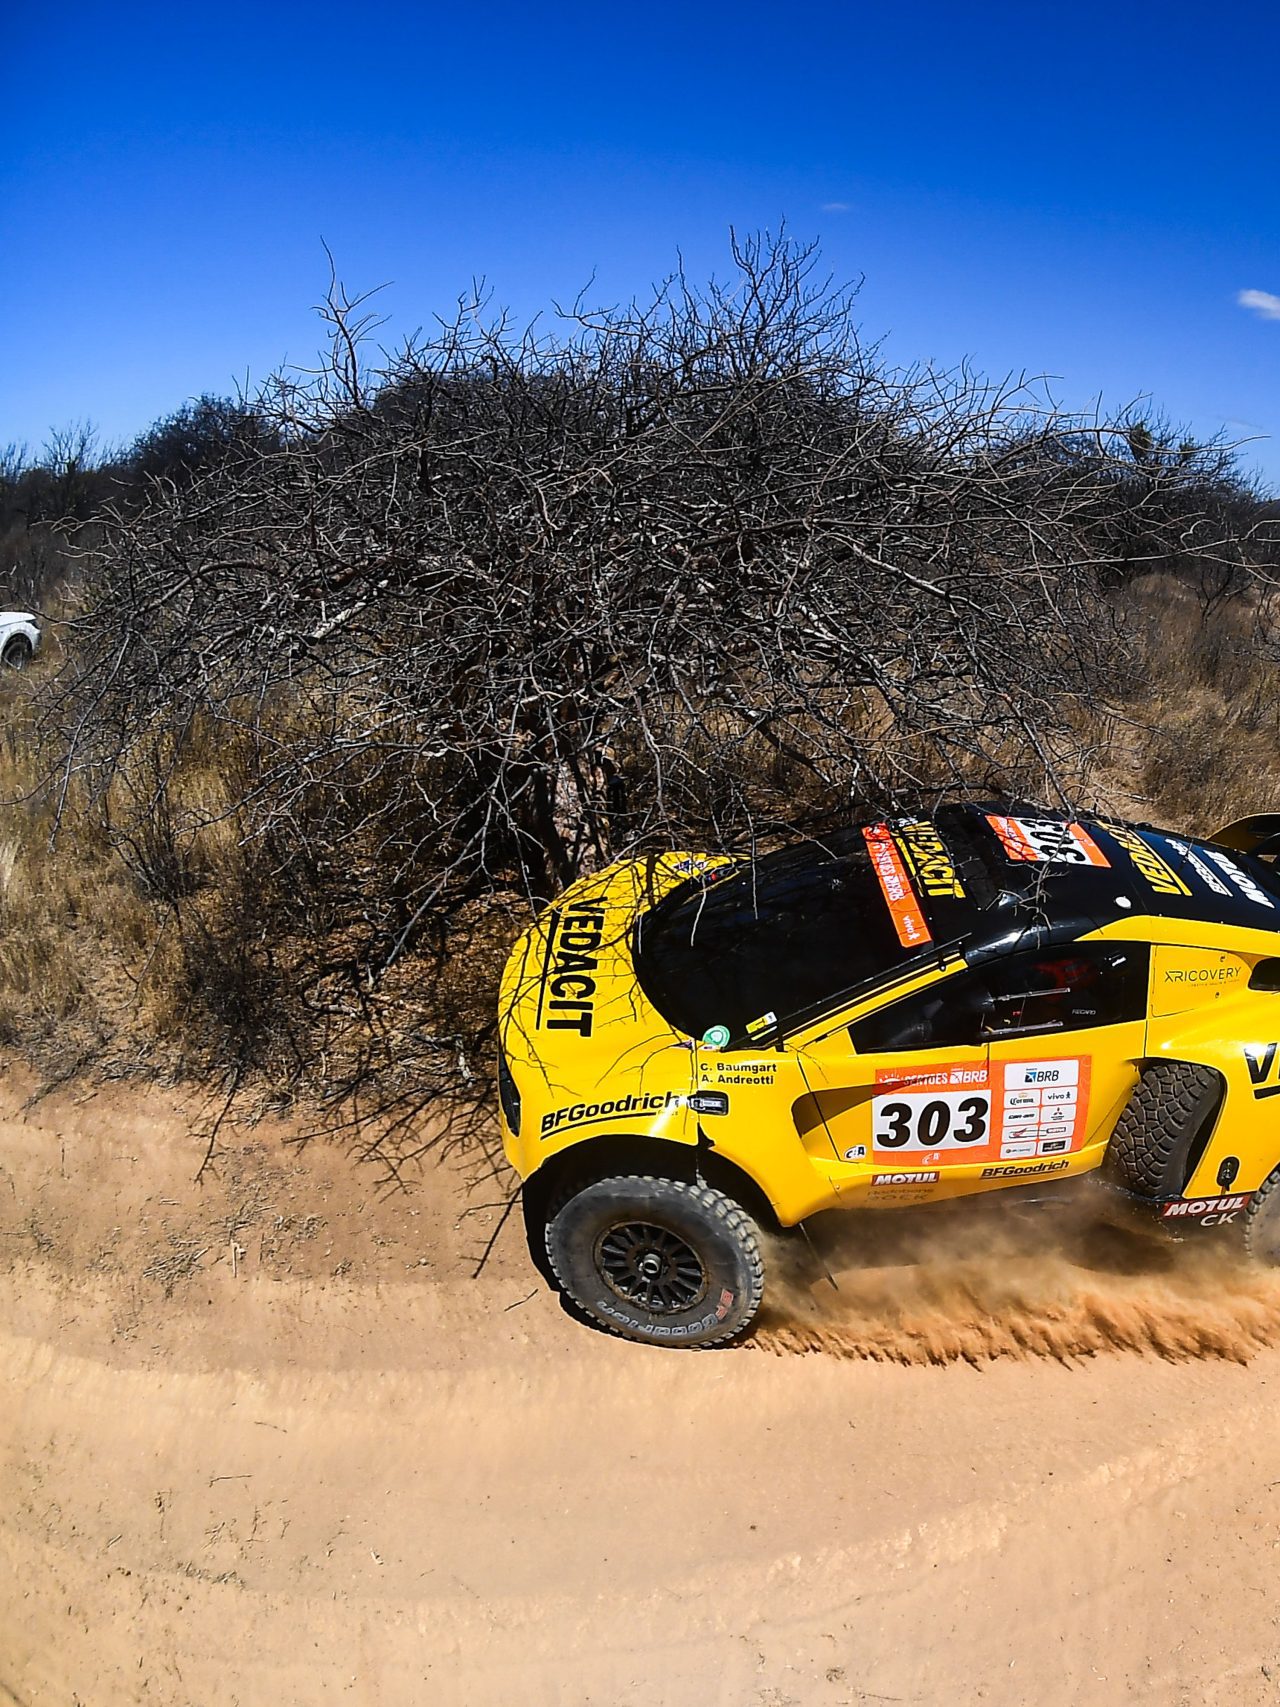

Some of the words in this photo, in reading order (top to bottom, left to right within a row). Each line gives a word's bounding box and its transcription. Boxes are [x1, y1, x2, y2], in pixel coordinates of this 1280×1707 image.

[546, 896, 608, 1038] VEDACIT
[700, 1062, 713, 1072] C.
[716, 1062, 777, 1074] Baumgart
[963, 1069, 988, 1083] BRB
[1037, 1070, 1059, 1082] BRB
[701, 1074, 714, 1084] A.
[717, 1074, 774, 1085] Andreotti
[1047, 1093, 1065, 1101] vivo
[541, 1091, 681, 1133] BFGoodrich
[876, 1096, 989, 1148] 303
[981, 1160, 1069, 1178] BFGoodrich
[874, 1172, 938, 1186] MOTUL
[1164, 1196, 1245, 1217] MOTUL
[1200, 1211, 1239, 1227] CK
[596, 1288, 735, 1337] BFGoodrich
